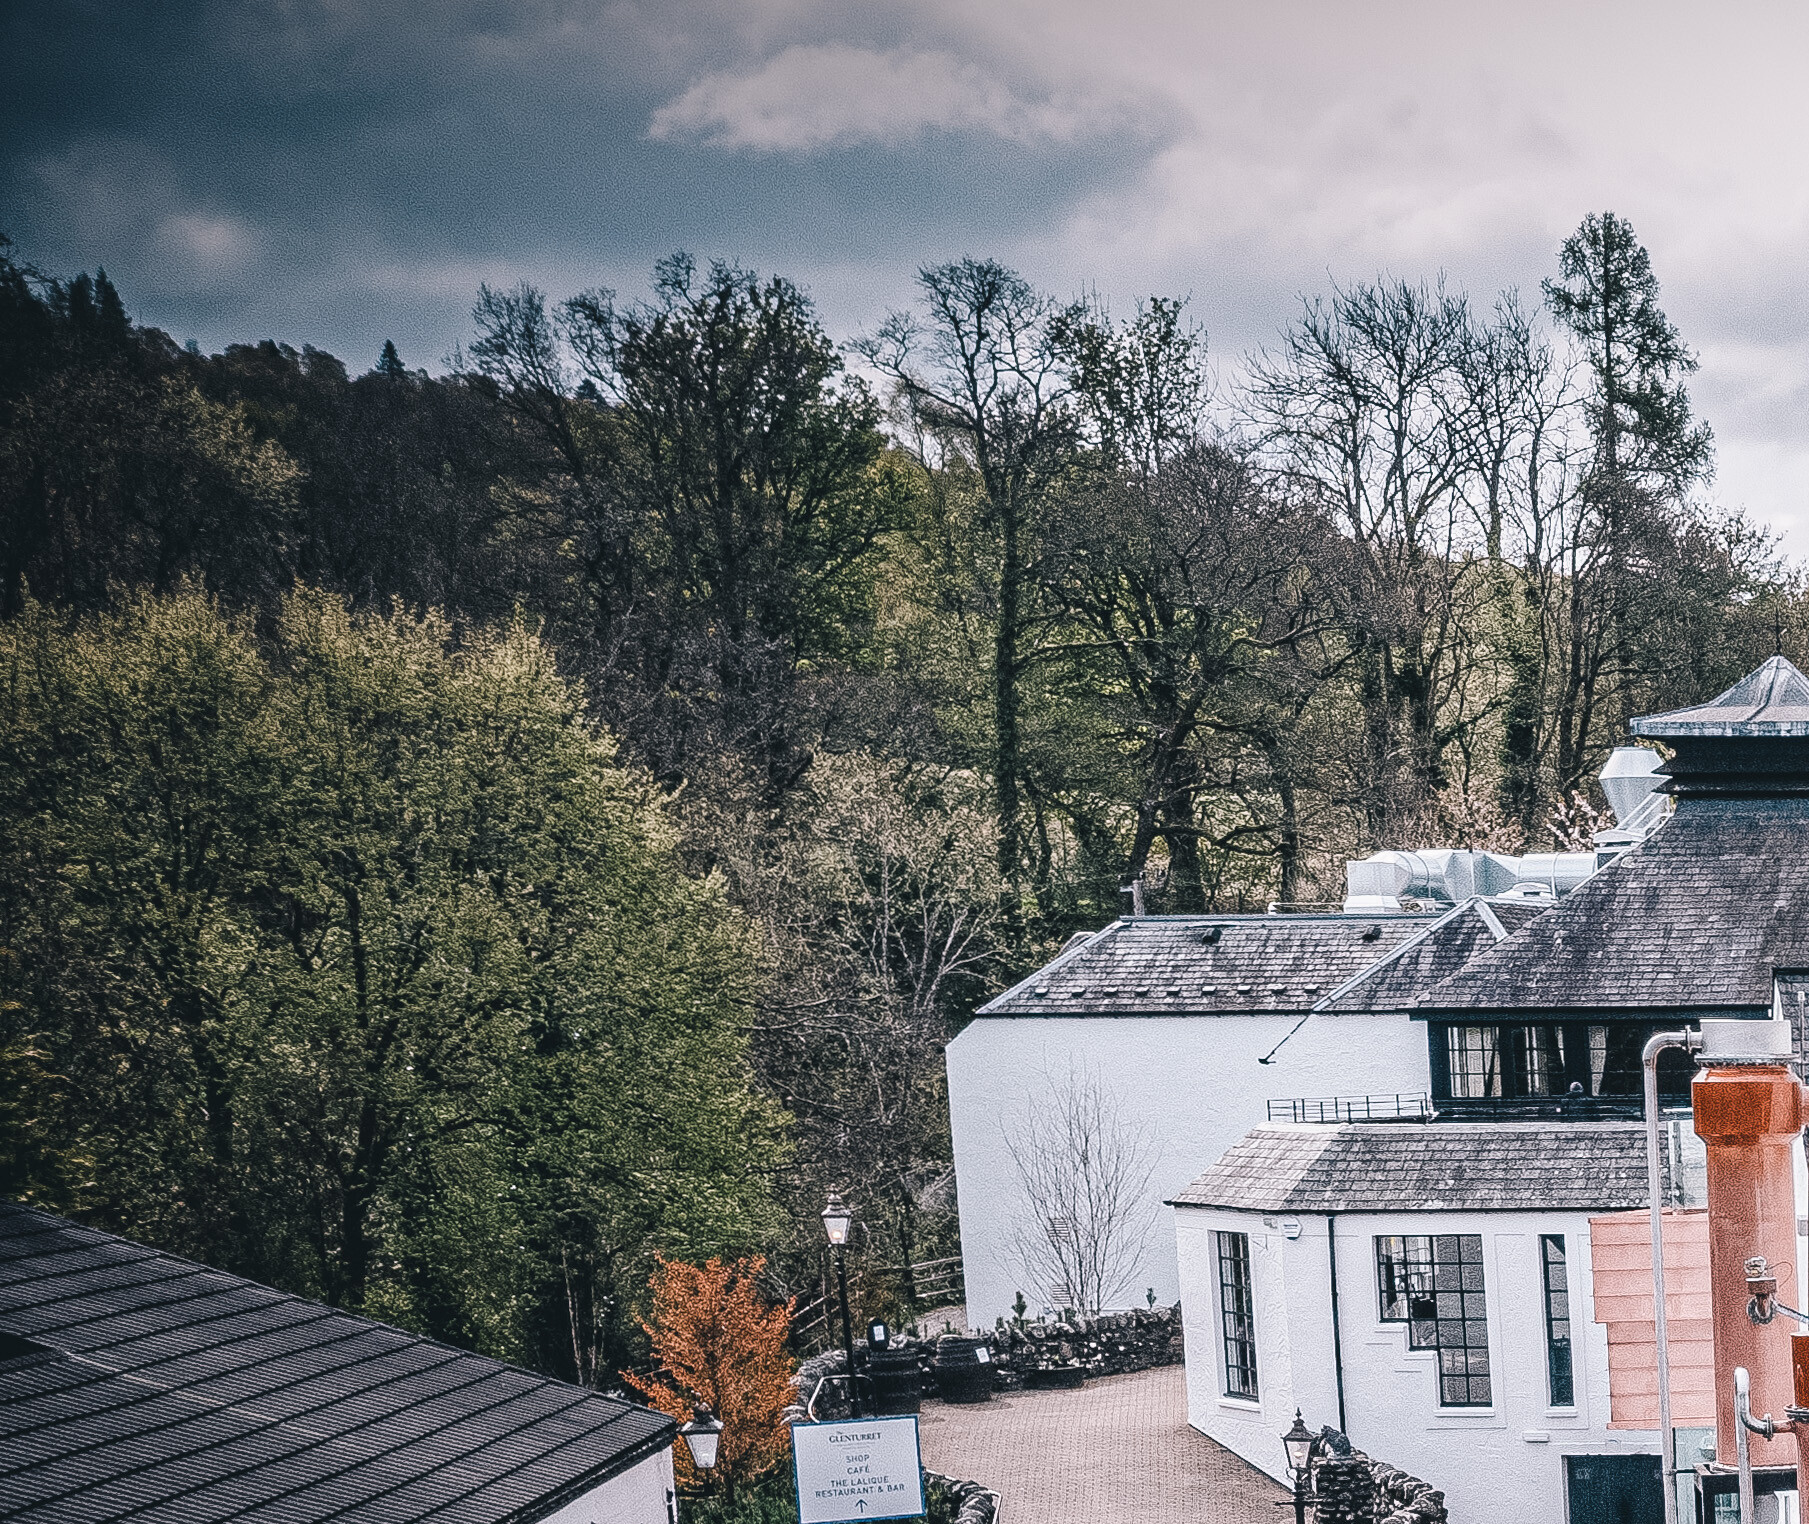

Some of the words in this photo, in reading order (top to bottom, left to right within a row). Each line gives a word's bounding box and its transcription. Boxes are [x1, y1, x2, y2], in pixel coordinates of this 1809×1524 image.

[845, 1454, 870, 1463] SHOP
[830, 1480, 848, 1488] THE
[850, 1475, 889, 1487] LALIQUE
[815, 1486, 874, 1498] RESTAURANT
[887, 1483, 905, 1493] BAR
